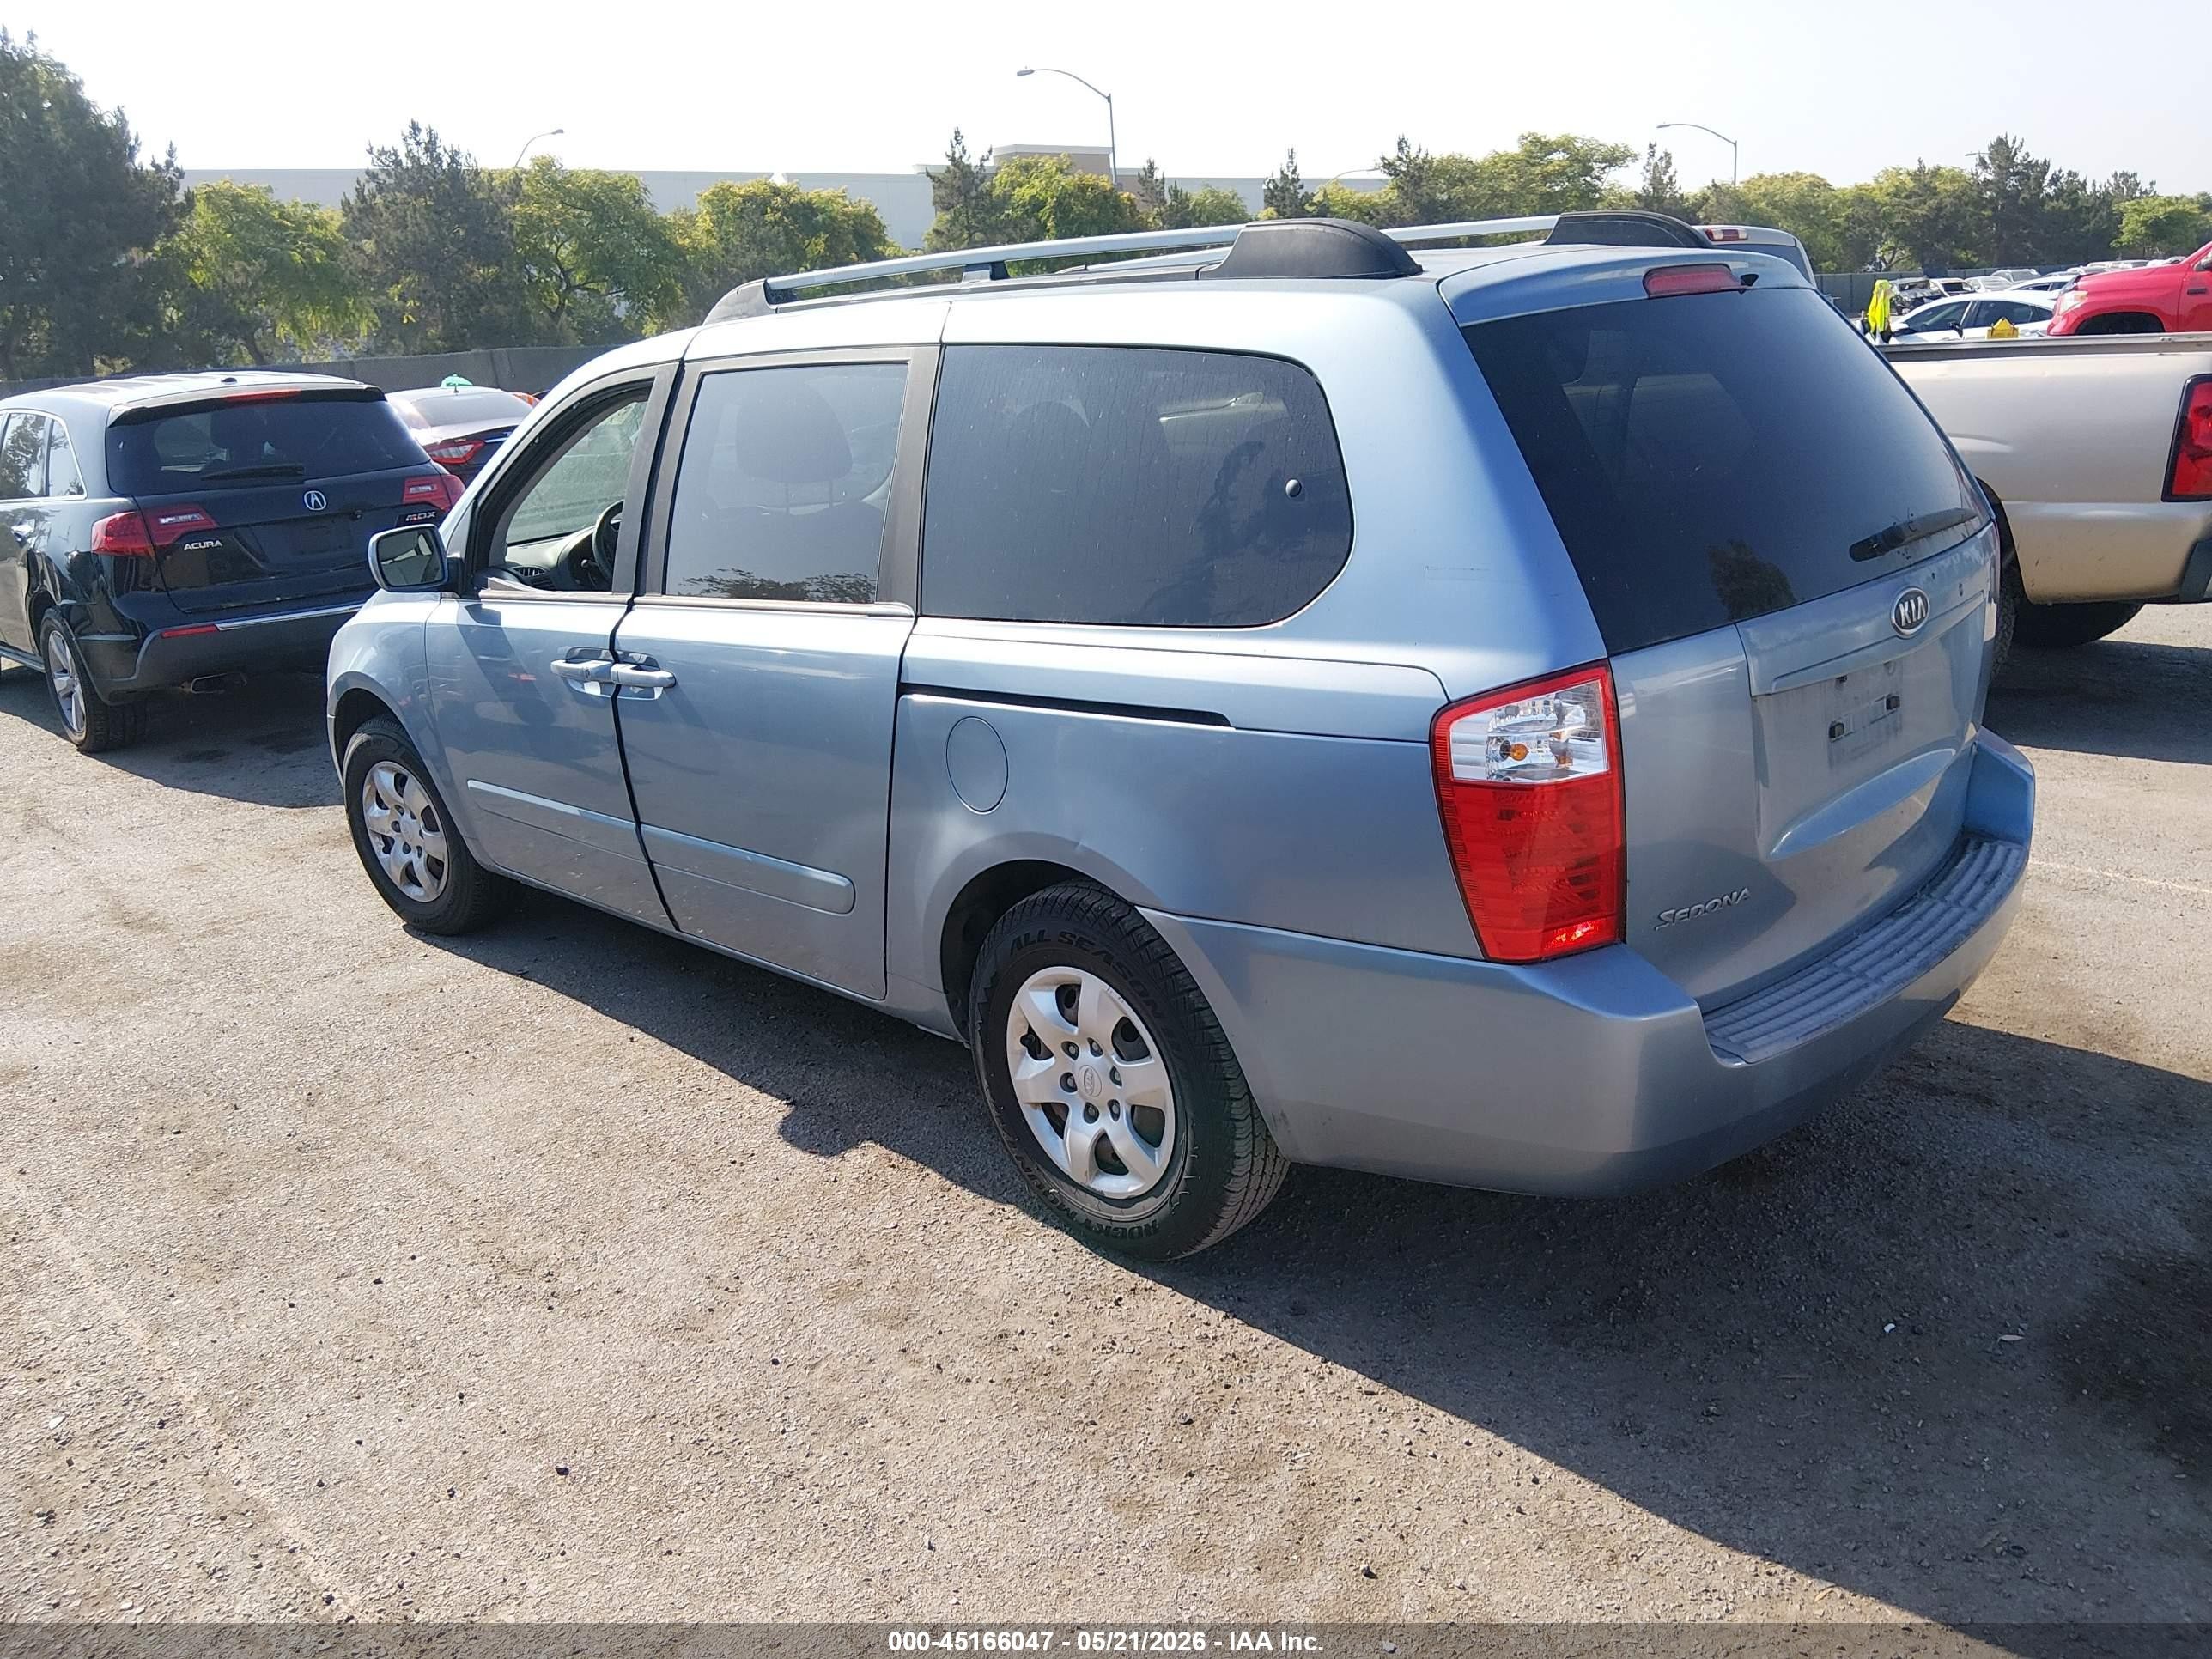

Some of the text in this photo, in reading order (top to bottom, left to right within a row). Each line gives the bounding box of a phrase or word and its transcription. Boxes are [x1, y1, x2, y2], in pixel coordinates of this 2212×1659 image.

[405, 511, 436, 521] MDX
[184, 540, 223, 550] ACURA
[1899, 596, 1926, 627] KIA
[1654, 887, 1752, 932] SEDONA
[1010, 929, 1163, 1019] ALL SEASON
[1084, 1217, 1158, 1240] ROCKY
